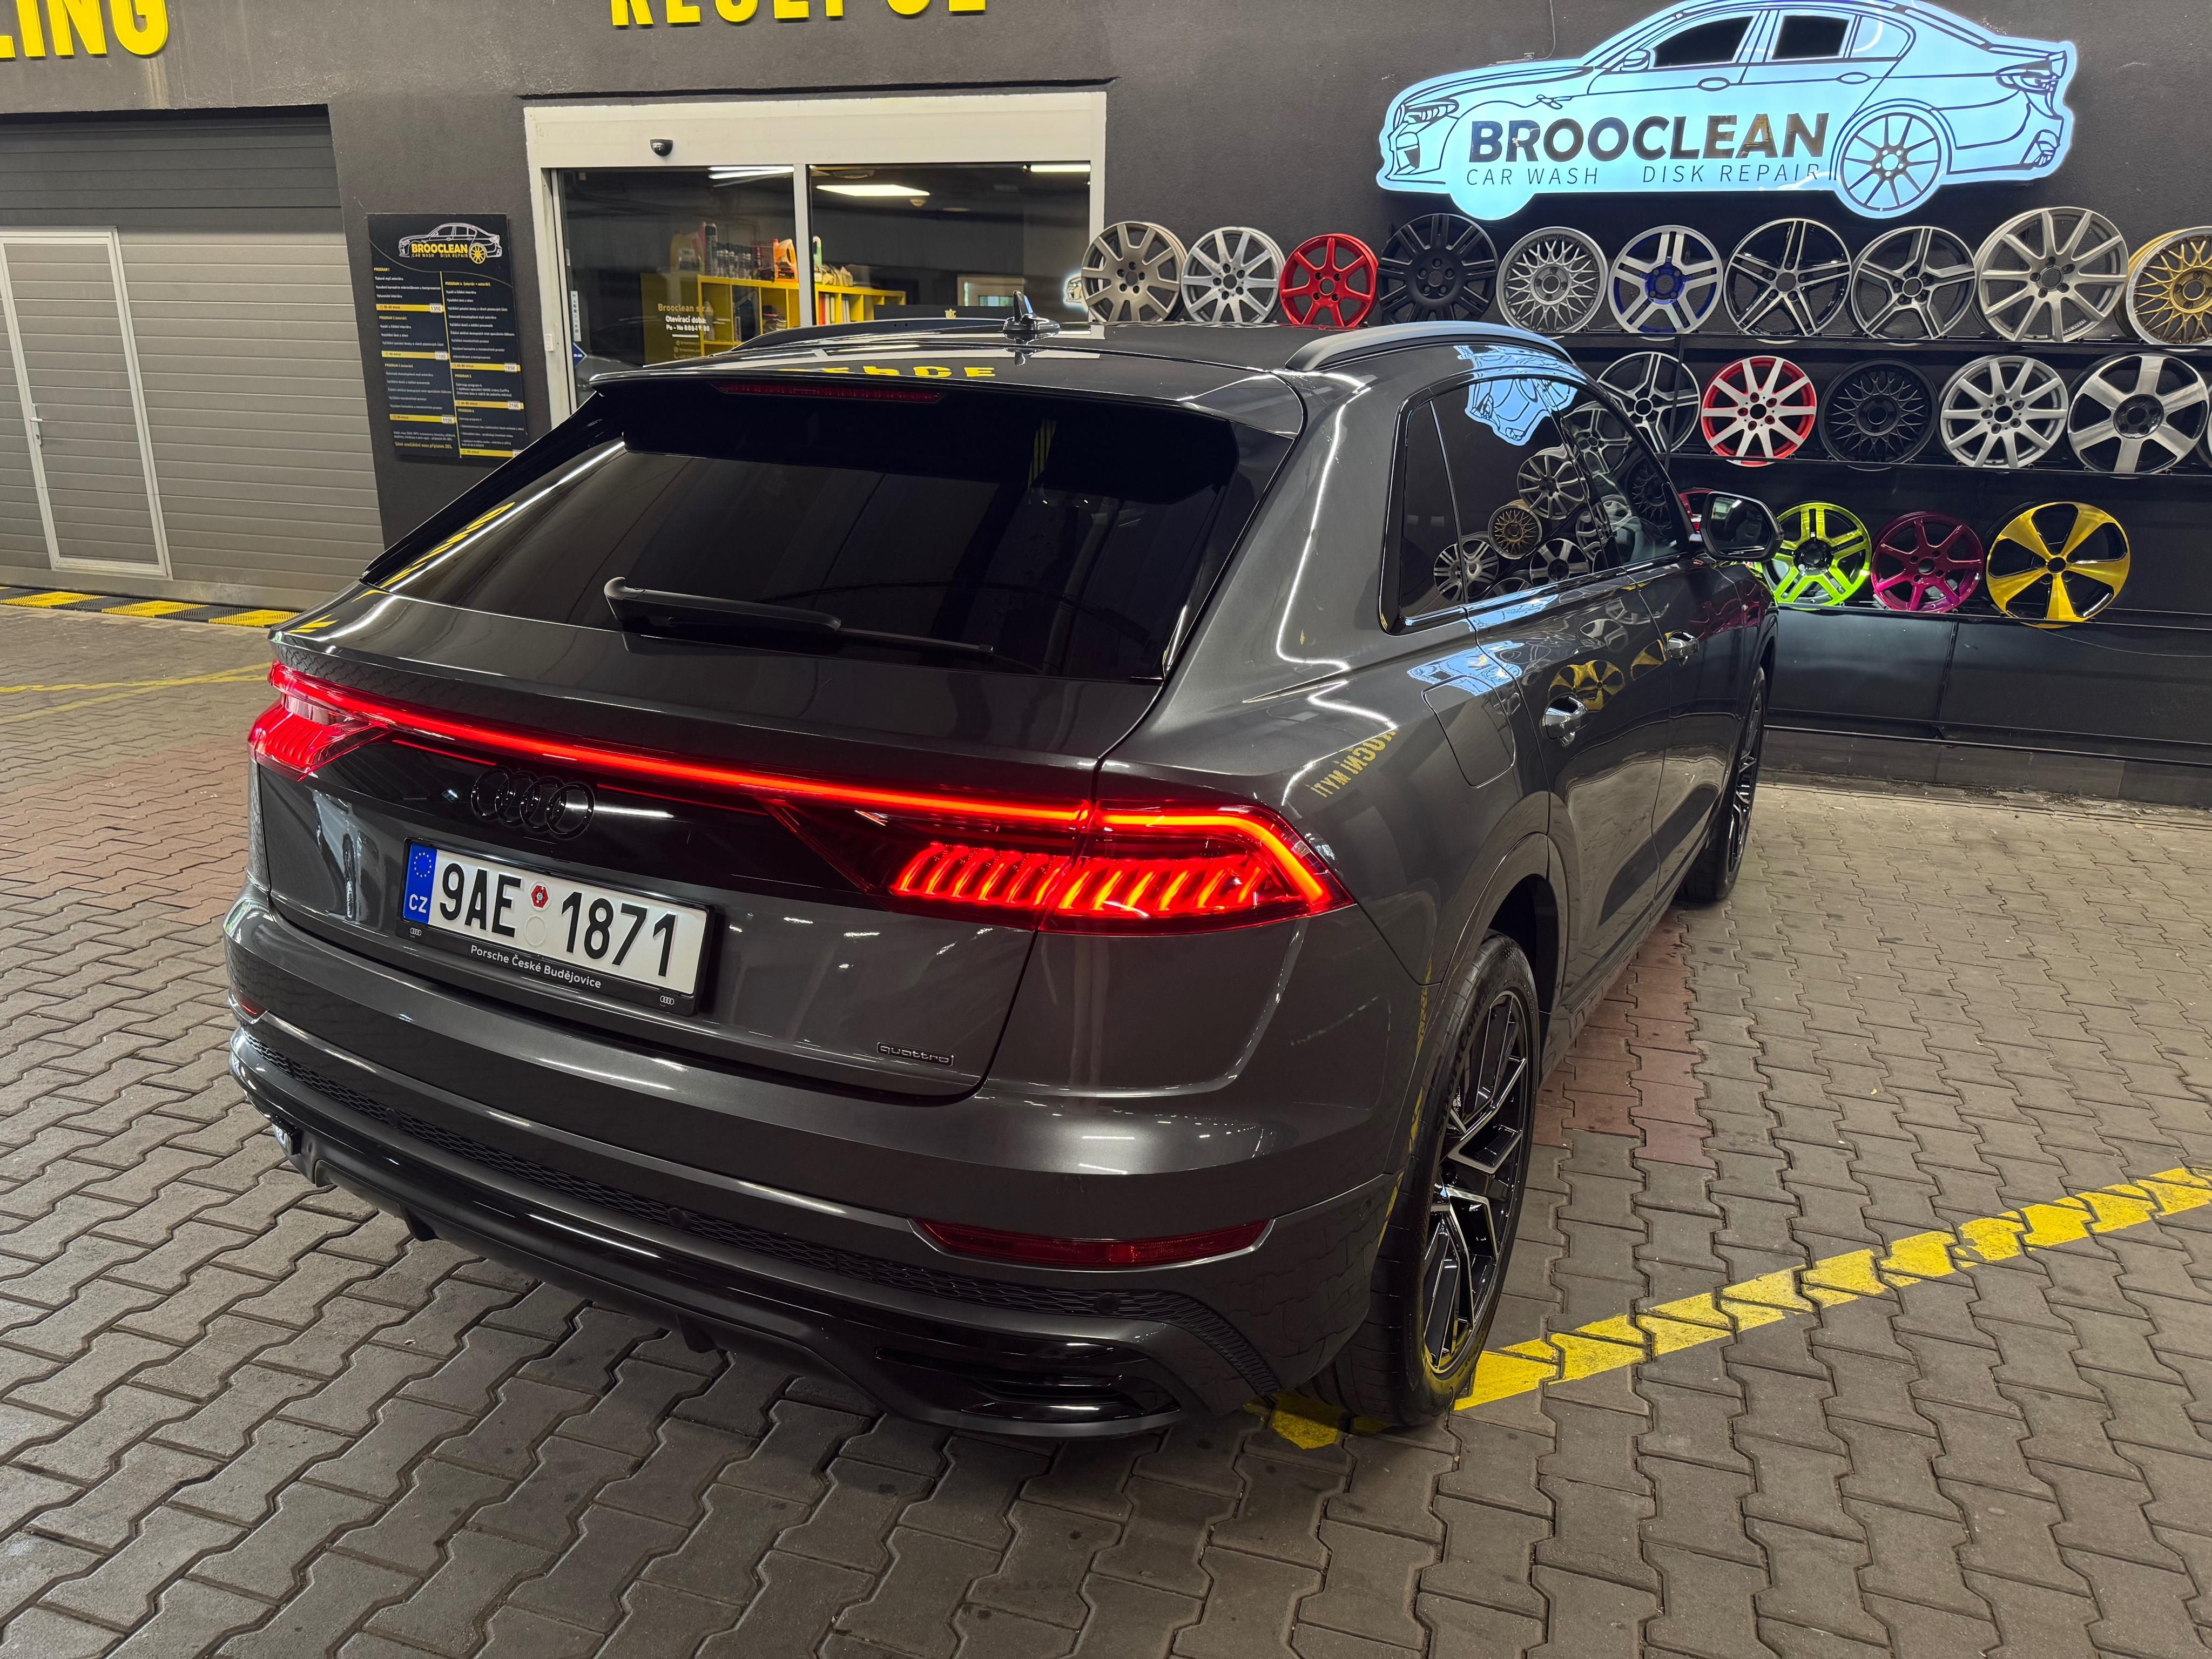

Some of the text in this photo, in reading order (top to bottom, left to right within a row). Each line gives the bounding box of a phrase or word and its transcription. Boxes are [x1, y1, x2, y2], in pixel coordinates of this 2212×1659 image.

[1469, 113, 1829, 162] BROOCLEAN
[1467, 164, 1819, 185] CAR WASH DISK REPAIR
[411, 244, 468, 253] BROOCLEAN
[658, 304, 694, 312] Brooclean
[409, 894, 428, 914] CZ
[440, 863, 676, 977] 9AE 1871
[470, 945, 601, 988] Porsche České Budějovice
[880, 1046, 949, 1063] quattro
